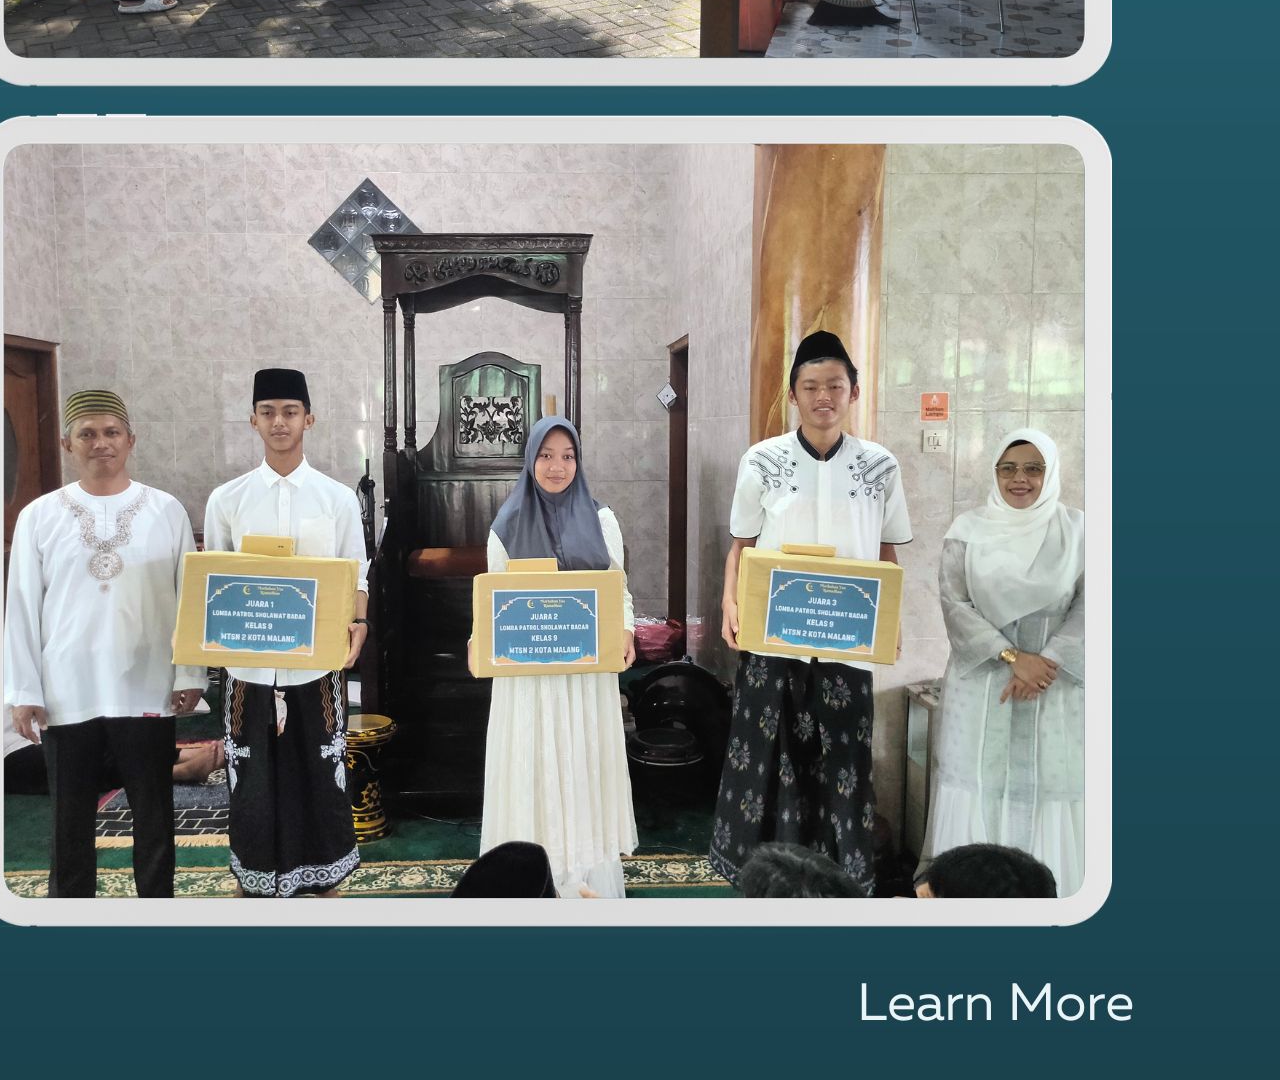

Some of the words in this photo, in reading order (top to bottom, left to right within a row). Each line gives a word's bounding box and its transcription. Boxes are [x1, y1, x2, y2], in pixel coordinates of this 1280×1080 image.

[808, 597, 831, 606] JUARA
[806, 619, 828, 627] KELAS
[782, 628, 801, 636] MTSN
[808, 630, 826, 639] KOTA
[828, 633, 856, 641] MALANG
[267, 635, 295, 643] MALANG
